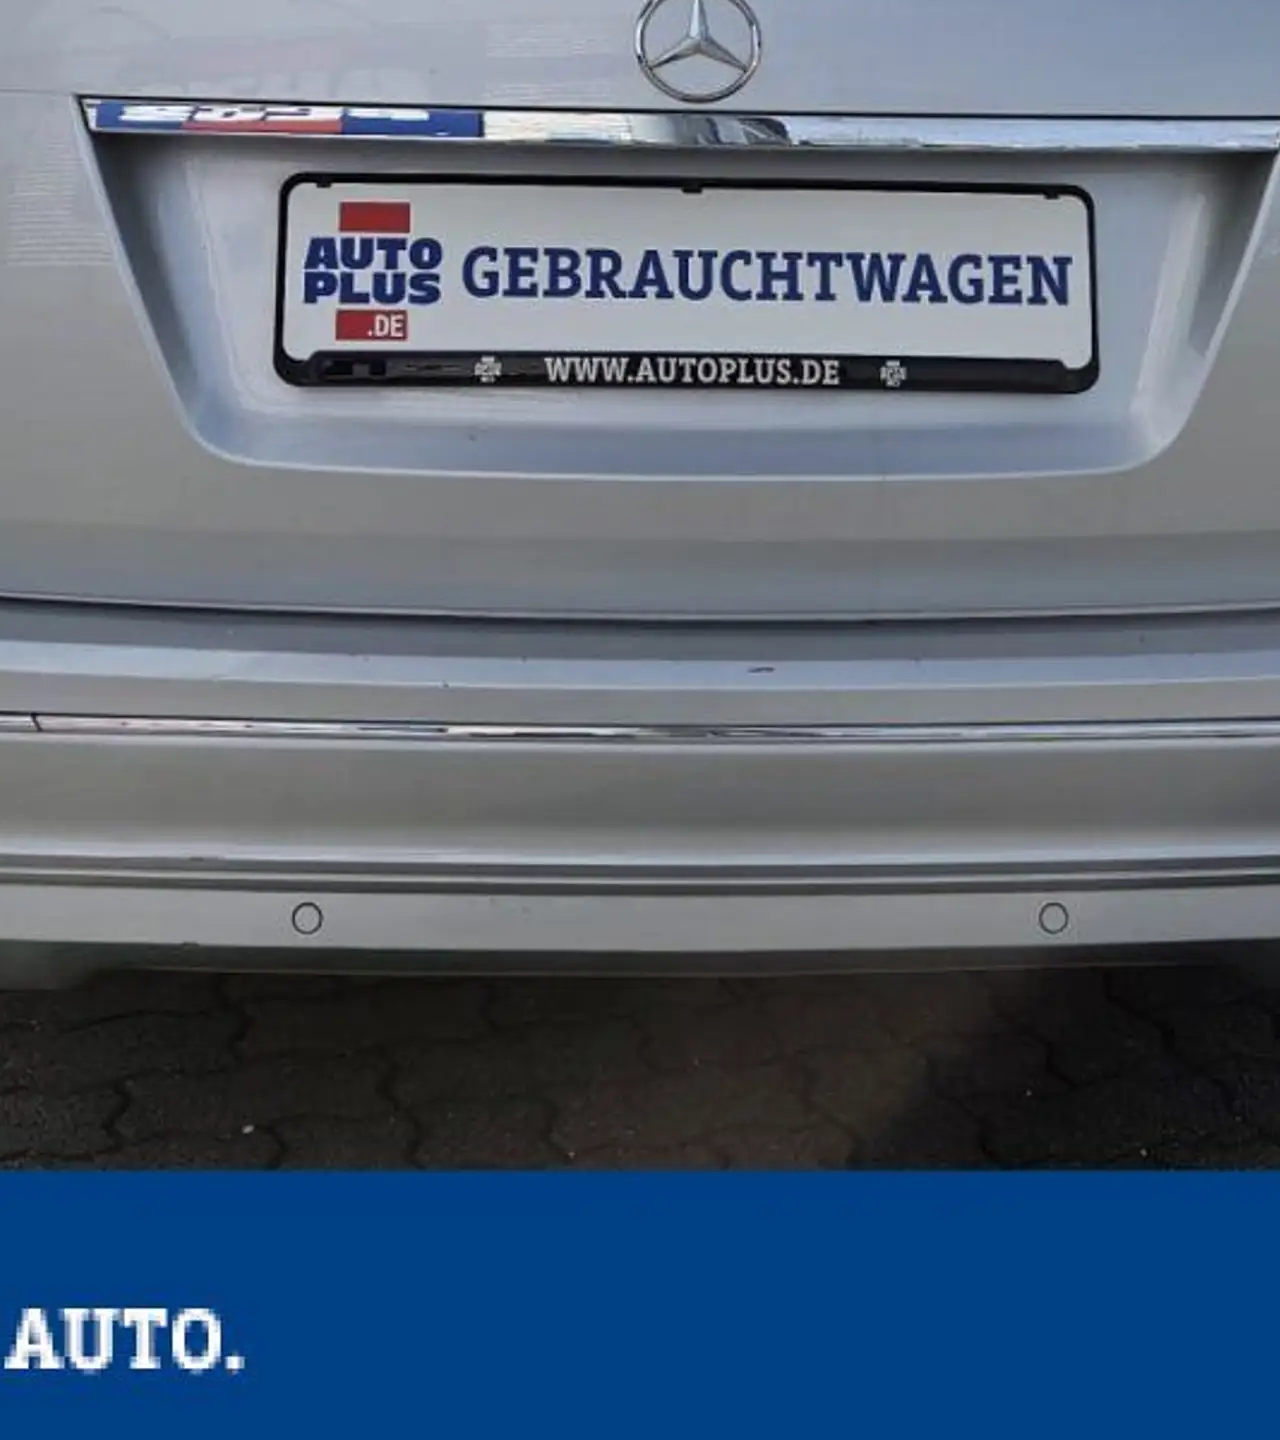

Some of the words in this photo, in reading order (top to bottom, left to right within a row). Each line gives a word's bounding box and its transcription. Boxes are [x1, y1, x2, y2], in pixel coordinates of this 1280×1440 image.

[303, 236, 443, 271] AUTO
[303, 271, 442, 306] PLUS
[461, 247, 1073, 306] GEBRAUCHTWAGEN
[367, 314, 405, 338] .DE
[544, 356, 841, 386] WWW.AUTOPLUS.DE
